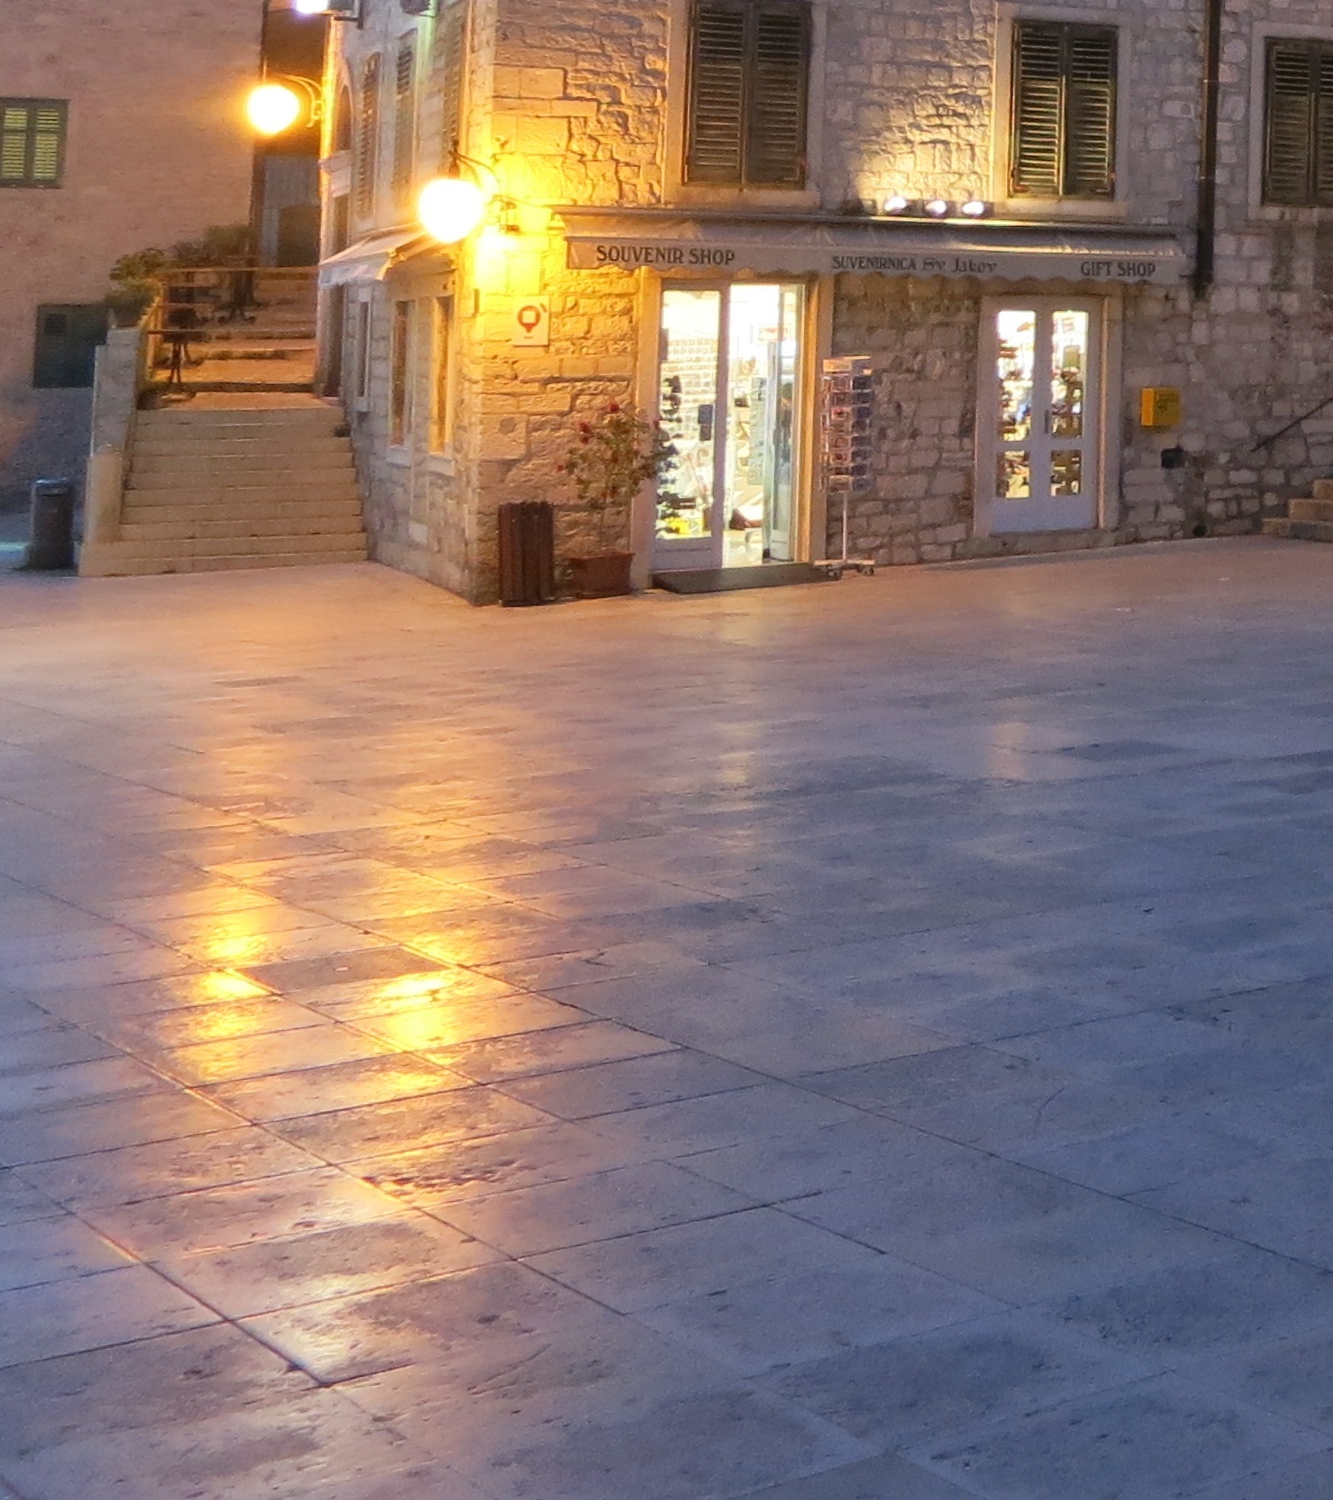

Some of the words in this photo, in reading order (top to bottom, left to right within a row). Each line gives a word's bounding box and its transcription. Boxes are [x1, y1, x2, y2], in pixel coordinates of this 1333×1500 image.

[596, 245, 684, 264] SOUVENIR
[688, 248, 735, 265] SHOP
[832, 255, 916, 271] SUVENIRNICA
[1080, 261, 1113, 276] GIFT
[1117, 262, 1156, 277] SHOP
